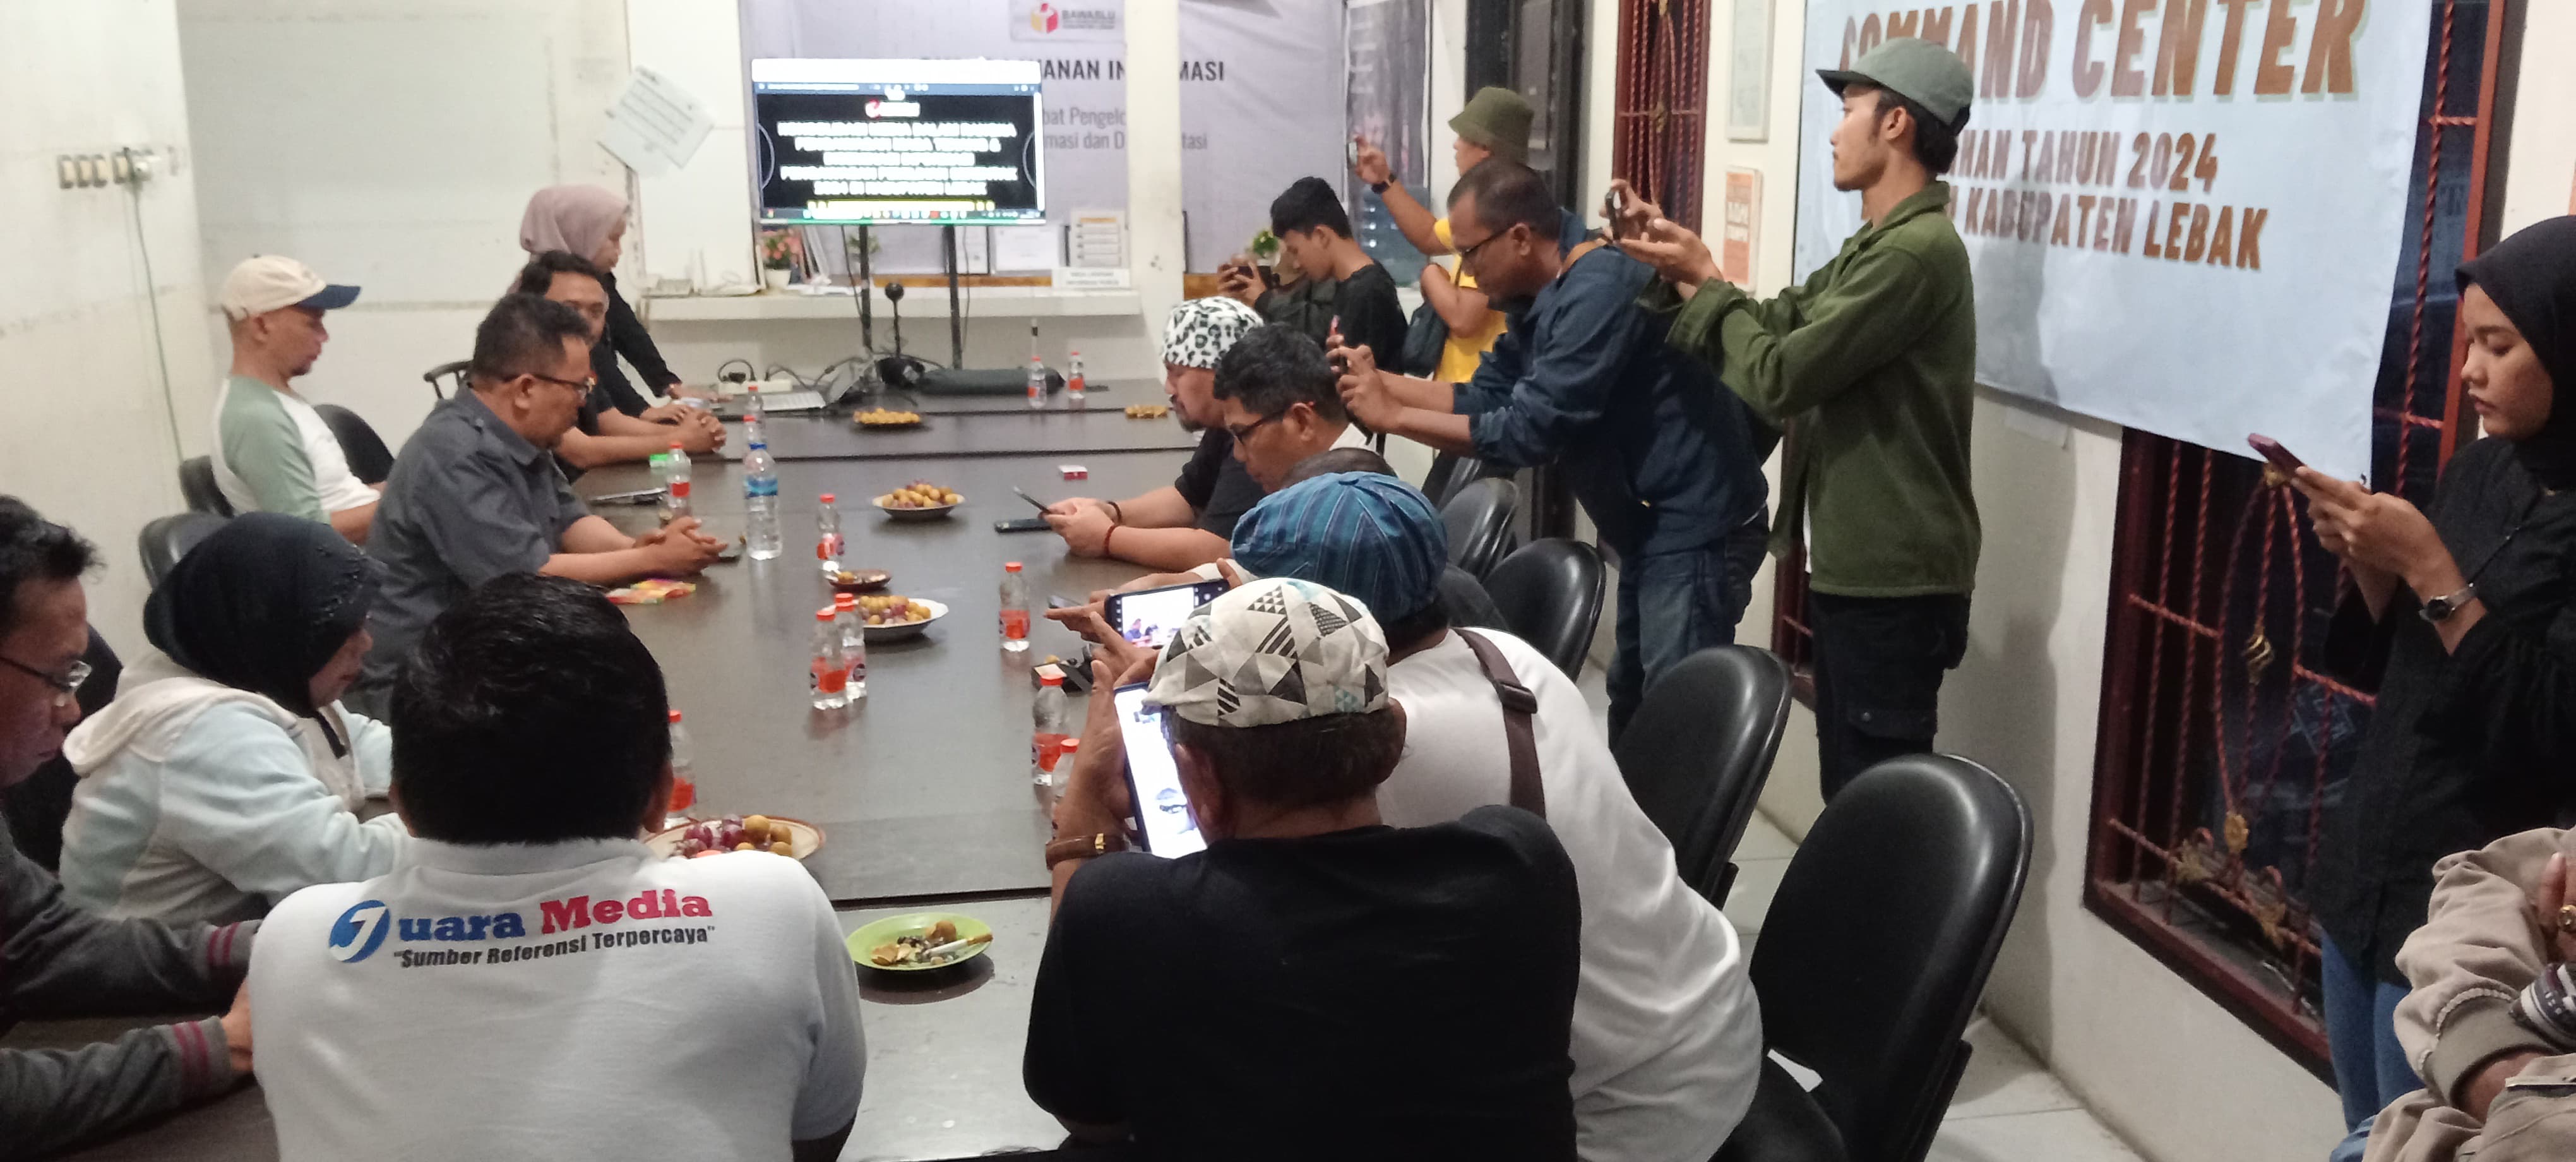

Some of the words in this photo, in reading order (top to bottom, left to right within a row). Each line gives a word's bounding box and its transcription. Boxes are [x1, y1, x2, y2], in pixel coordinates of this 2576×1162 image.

[2072, 0, 2366, 100] CENTER
[1083, 132, 1109, 149] dan
[2022, 130, 2121, 186] TAHUN
[2127, 131, 2218, 192] 2024
[1964, 186, 2137, 254] KABUPATEN
[2143, 199, 2269, 270] LEBAK
[540, 889, 713, 935] Media
[487, 935, 587, 964] Referensi
